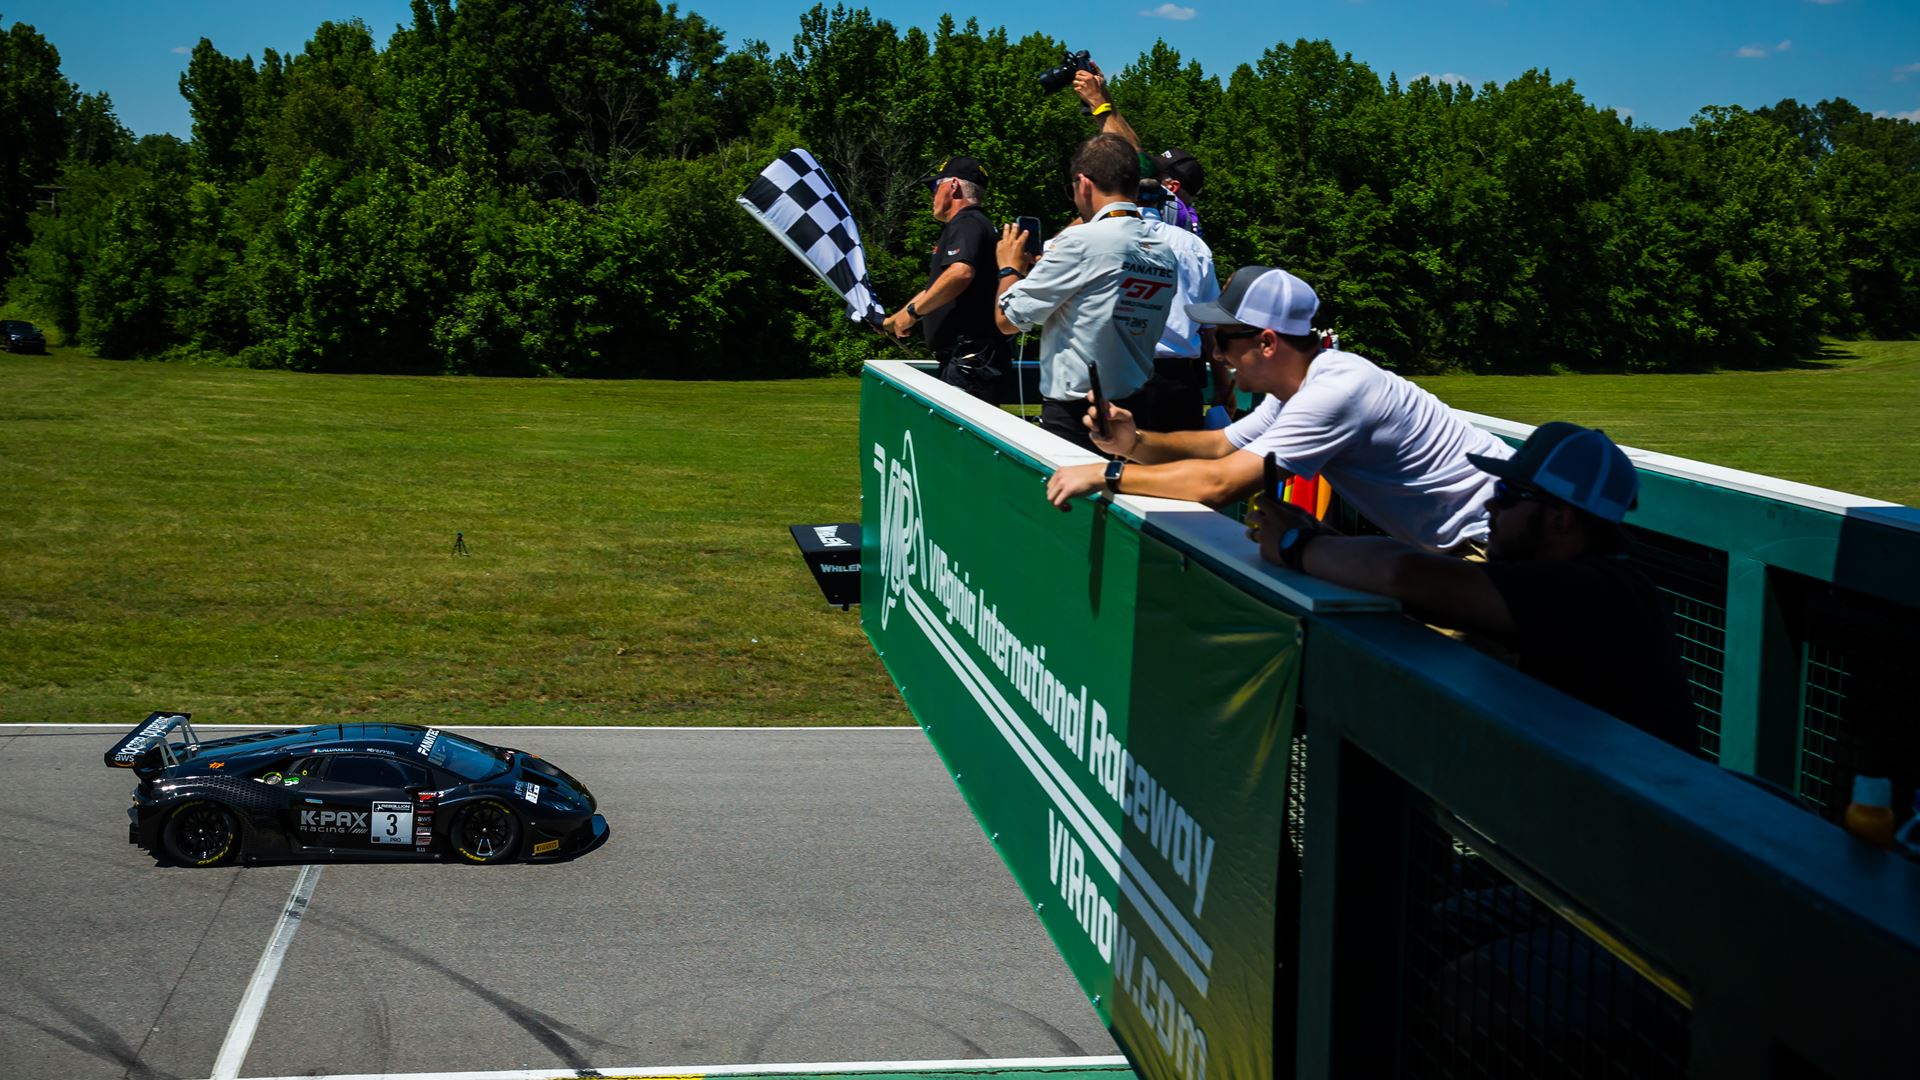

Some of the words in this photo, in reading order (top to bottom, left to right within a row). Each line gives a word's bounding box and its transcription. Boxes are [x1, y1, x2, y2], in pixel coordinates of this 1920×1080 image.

[1121, 261, 1174, 278] FANATEC
[1120, 277, 1173, 301] GT
[929, 538, 976, 638] VIRginia
[977, 588, 1088, 762] International
[1089, 699, 1217, 920] Raceway
[416, 728, 440, 756] FANATEC
[114, 754, 136, 763] aws
[301, 810, 369, 833] K-PAX
[386, 814, 398, 837] 3
[1048, 807, 1209, 1080] VIRnow.com
